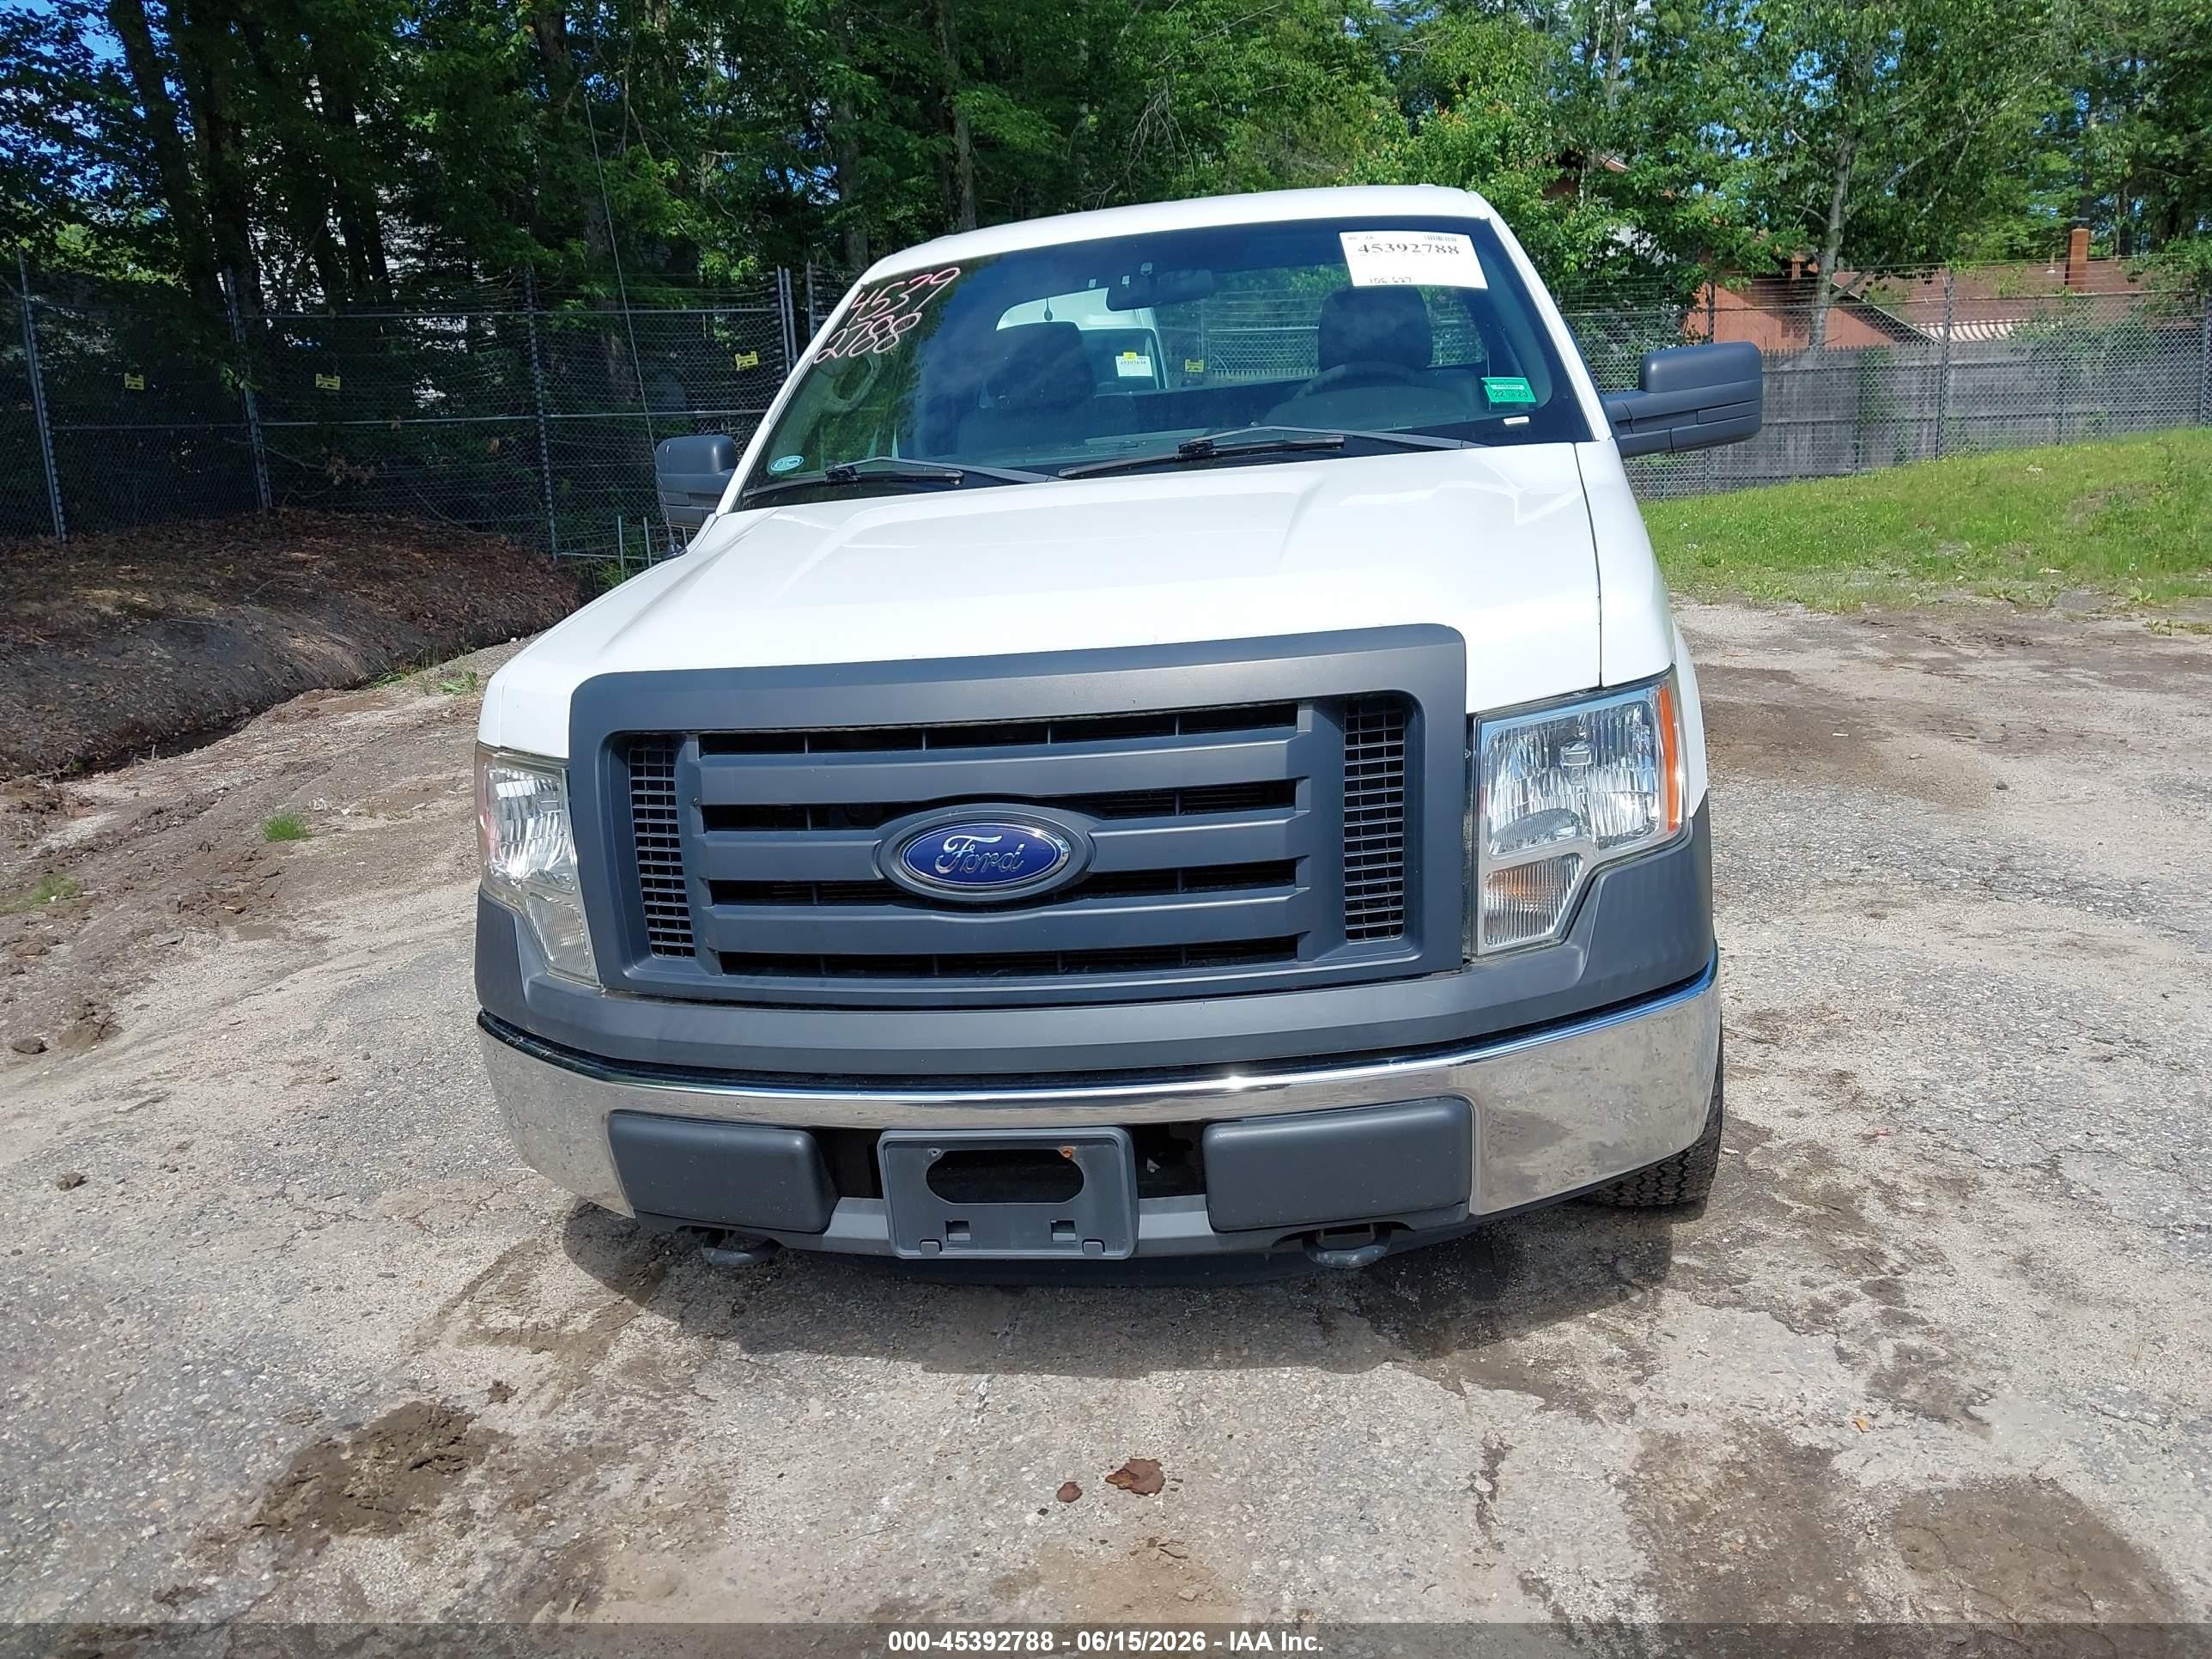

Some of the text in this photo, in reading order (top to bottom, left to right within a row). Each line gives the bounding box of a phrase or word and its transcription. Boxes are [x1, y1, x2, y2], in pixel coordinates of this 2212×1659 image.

[1358, 243, 1460, 255] 45392788
[813, 312, 922, 364] 2788
[934, 835, 1026, 874] Ford
